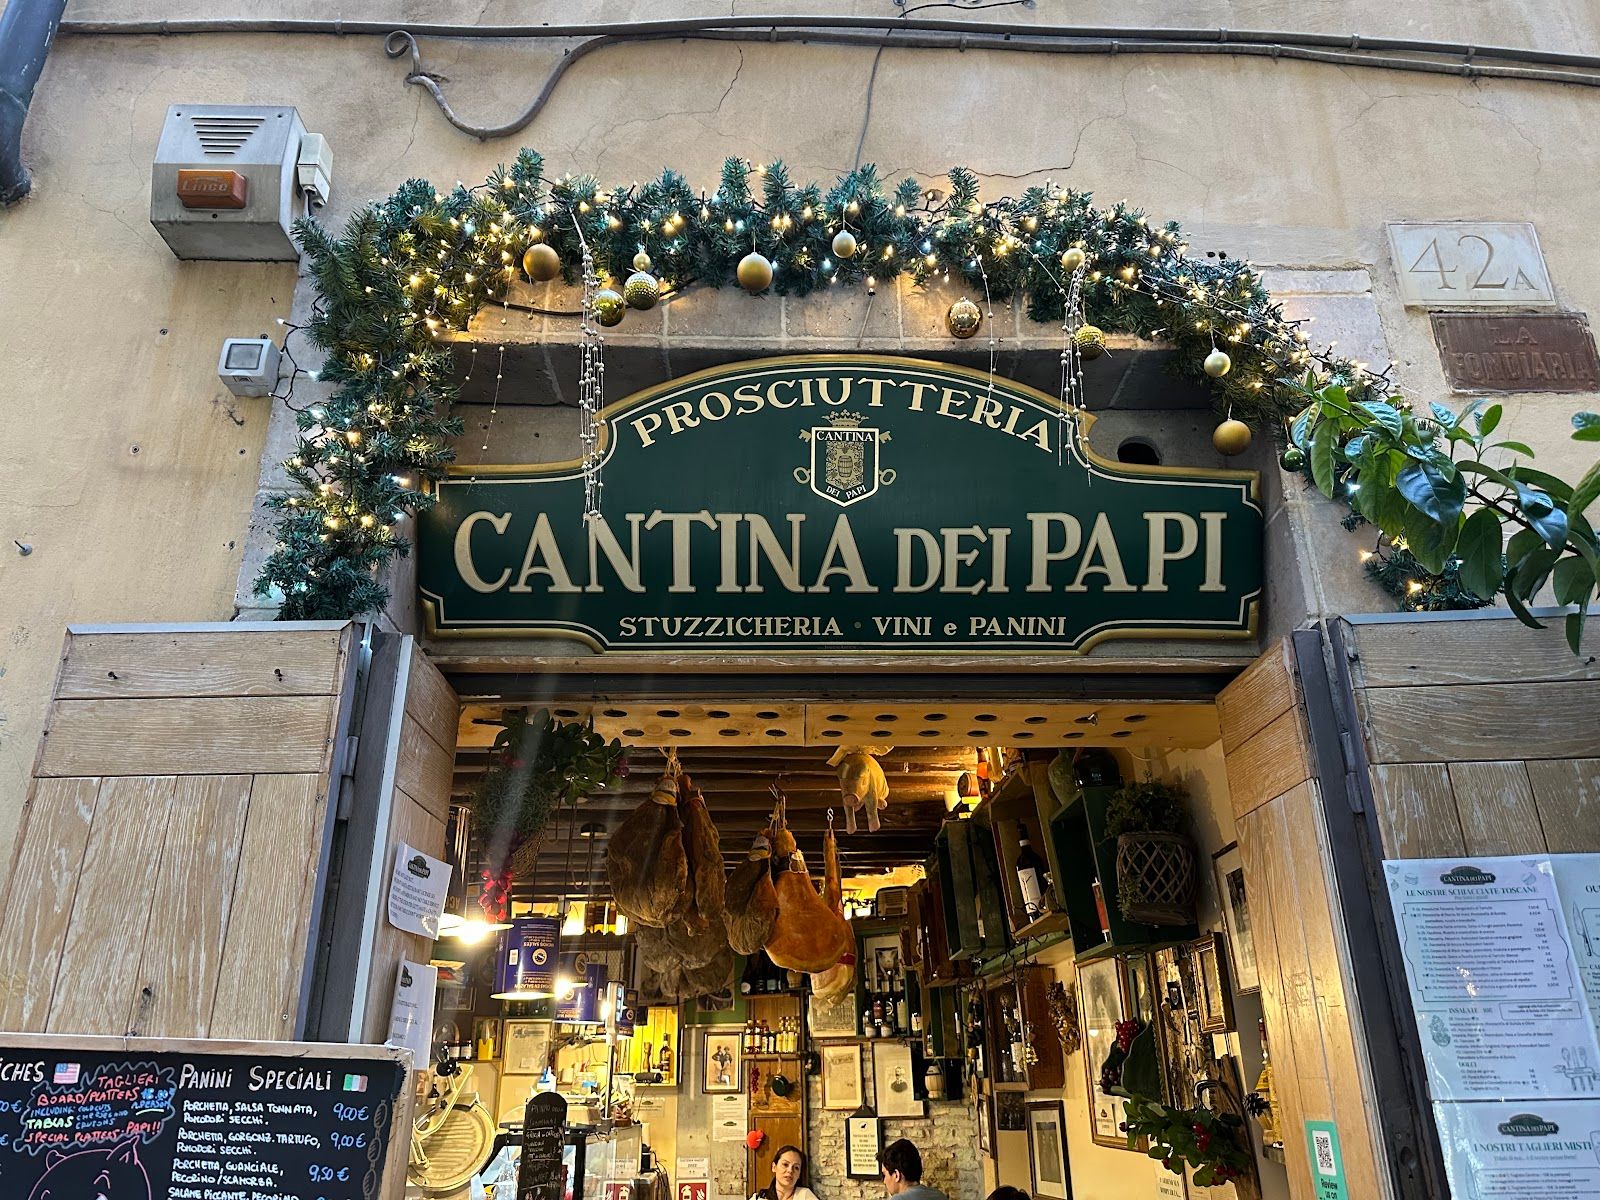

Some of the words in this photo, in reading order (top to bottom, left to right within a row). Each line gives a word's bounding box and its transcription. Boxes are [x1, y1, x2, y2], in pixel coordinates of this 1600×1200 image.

[1408, 234, 1540, 291] 42A
[1489, 325, 1539, 346] LA
[629, 376, 1054, 454] PROSCIUTTERIA
[816, 430, 874, 442] CANTINA
[826, 485, 840, 497] DEI
[846, 485, 866, 499] PAPI
[453, 509, 880, 594] CANTINA
[892, 524, 1012, 595] DEI
[1025, 511, 1228, 594] PAPI
[619, 615, 843, 637] STUZZICHERIA
[872, 616, 932, 637] VINI
[943, 621, 958, 637] e
[969, 616, 1066, 637] PANINI
[1406, 889, 1415, 897] LE
[98, 1073, 159, 1089] TAGLIERI
[235, 1102, 264, 1113] SALSA
[1480, 1142, 1515, 1153] NOSTRI
[1564, 1140, 1592, 1151] MISTI
